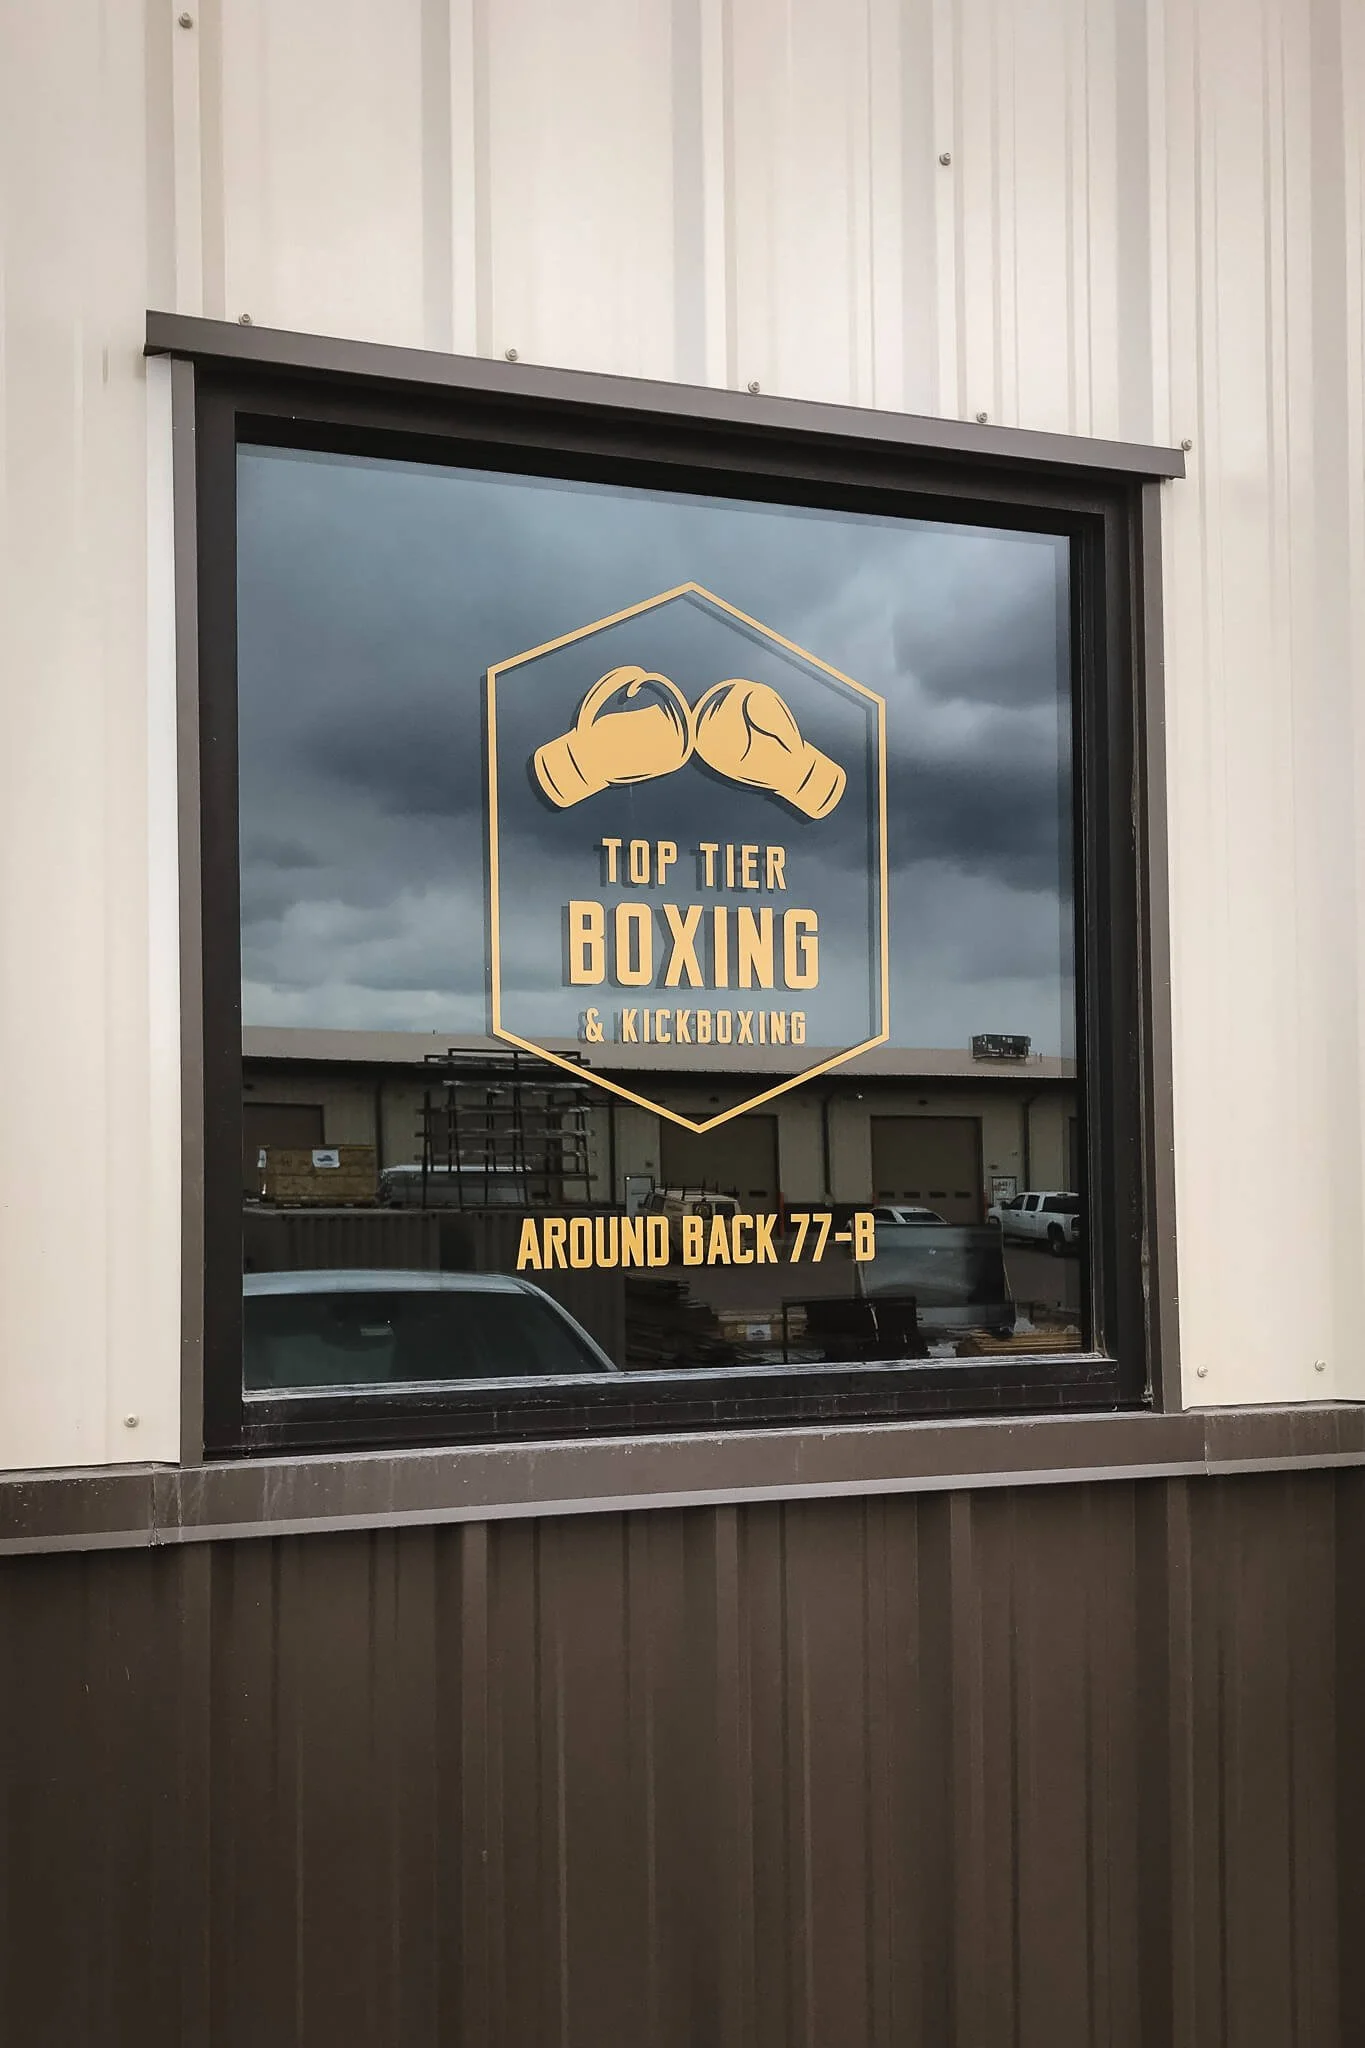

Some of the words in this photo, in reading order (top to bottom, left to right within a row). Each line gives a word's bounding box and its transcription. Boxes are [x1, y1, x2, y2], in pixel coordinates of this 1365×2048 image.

[602, 838, 678, 885] TOP
[700, 843, 787, 890] TIER
[569, 900, 820, 990] BOXING
[585, 1008, 605, 1042] &
[622, 1009, 808, 1045] KICKBOXING
[516, 1216, 671, 1271] AROUND
[682, 1213, 778, 1266] BACK
[790, 1212, 876, 1263] 77-B
